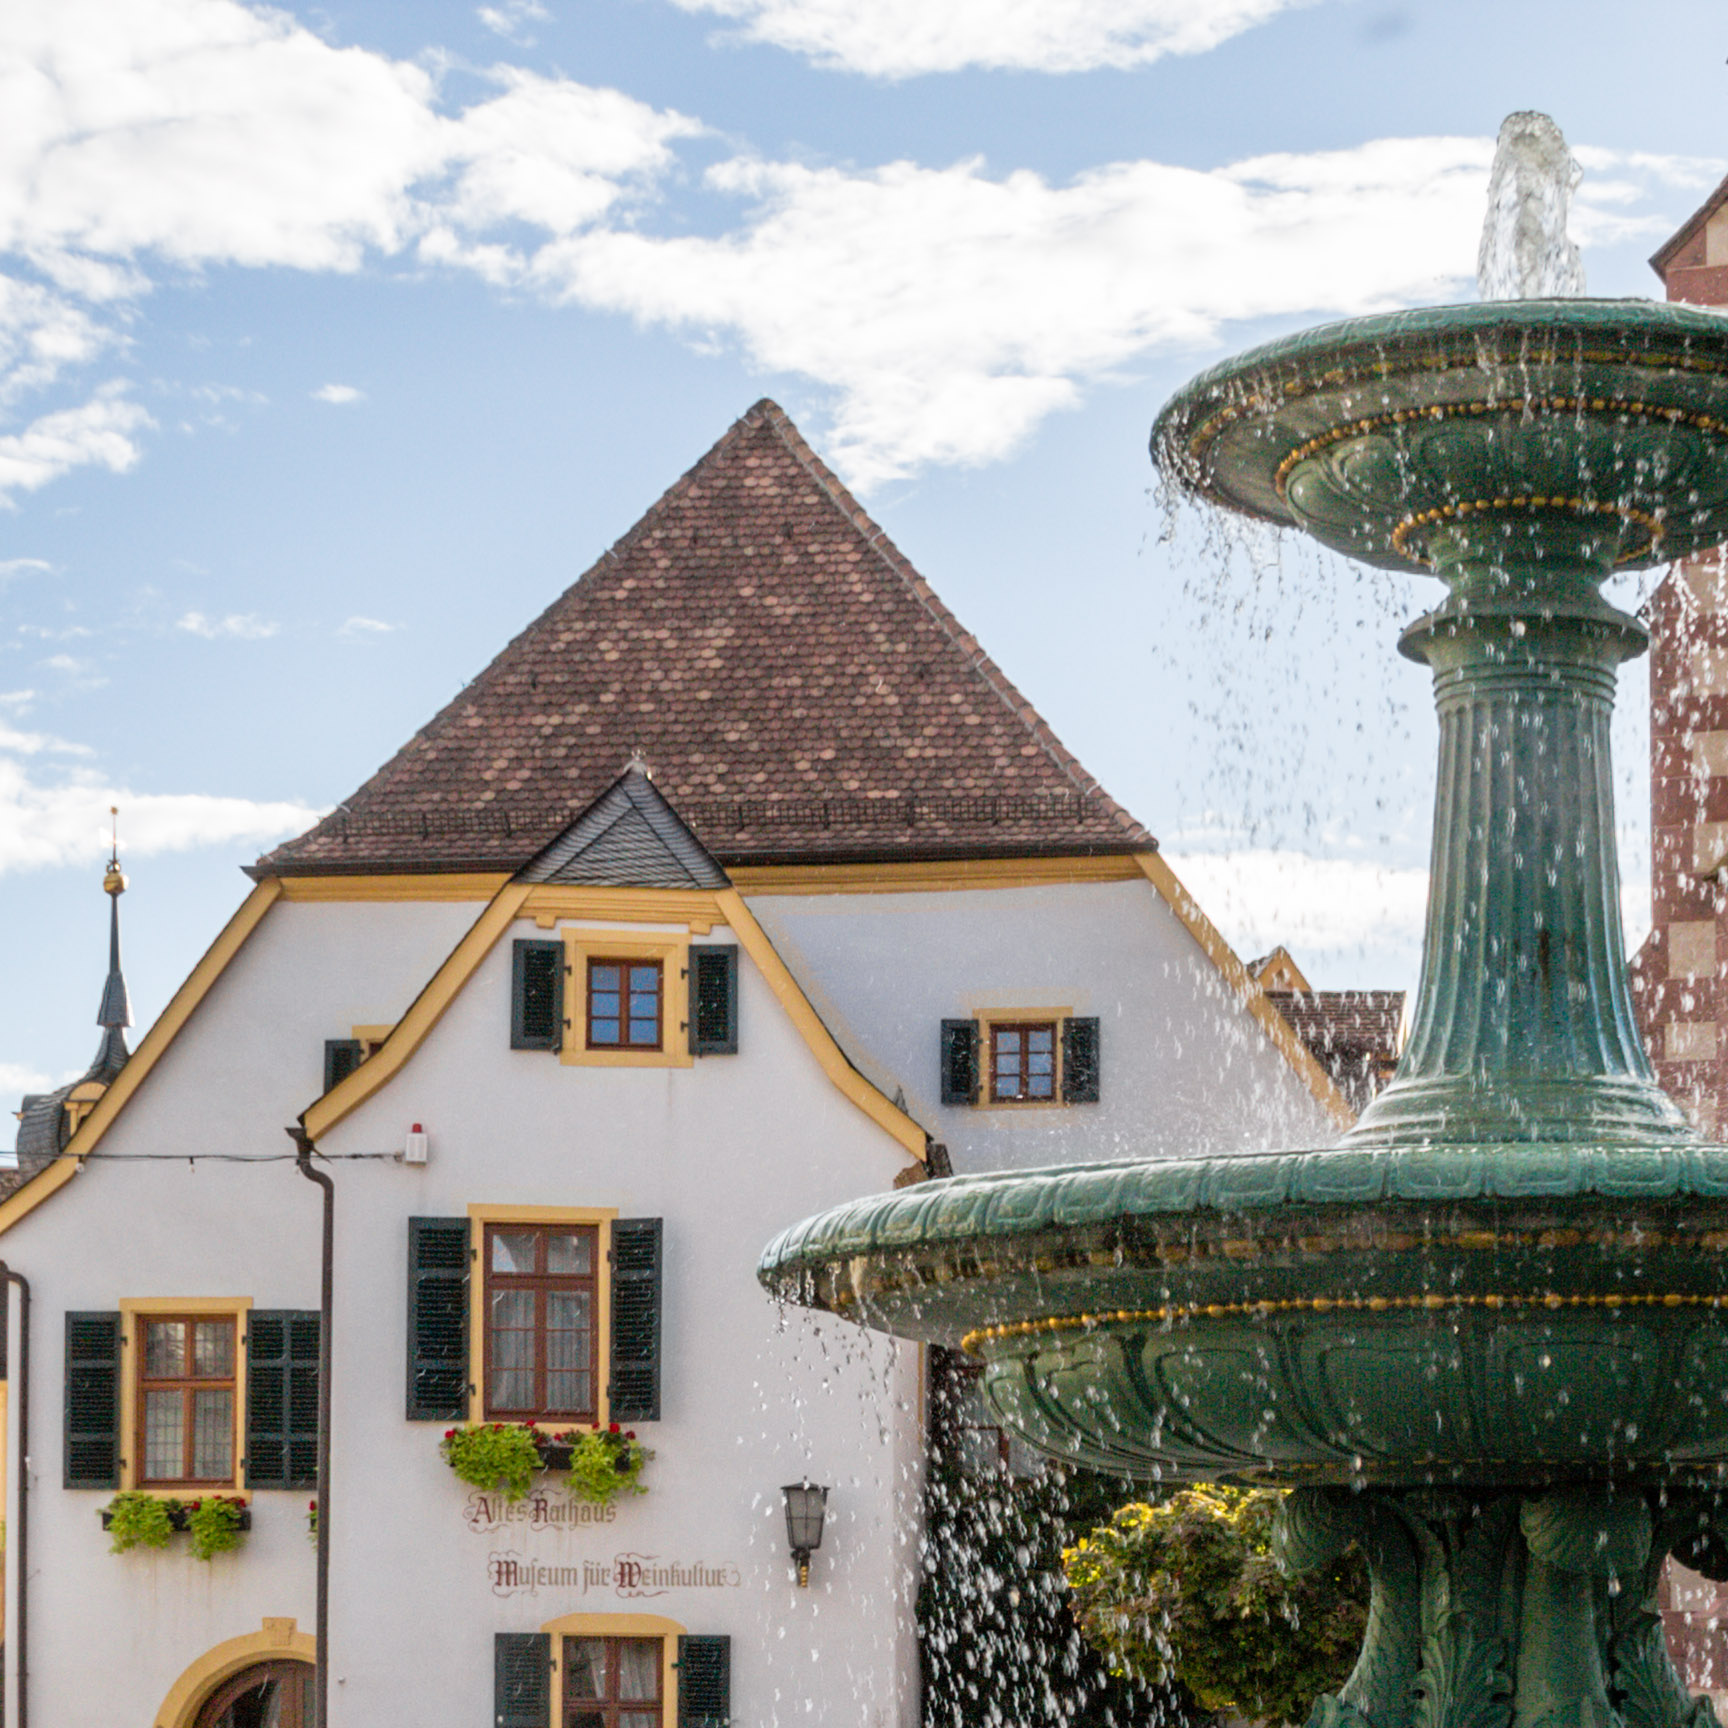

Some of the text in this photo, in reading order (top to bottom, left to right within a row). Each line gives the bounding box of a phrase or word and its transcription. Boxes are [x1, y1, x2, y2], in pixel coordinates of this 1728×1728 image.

[466, 1494, 616, 1530] Altes Rathaus
[583, 1560, 611, 1595] für
[615, 1554, 733, 1595] Weinkultur
